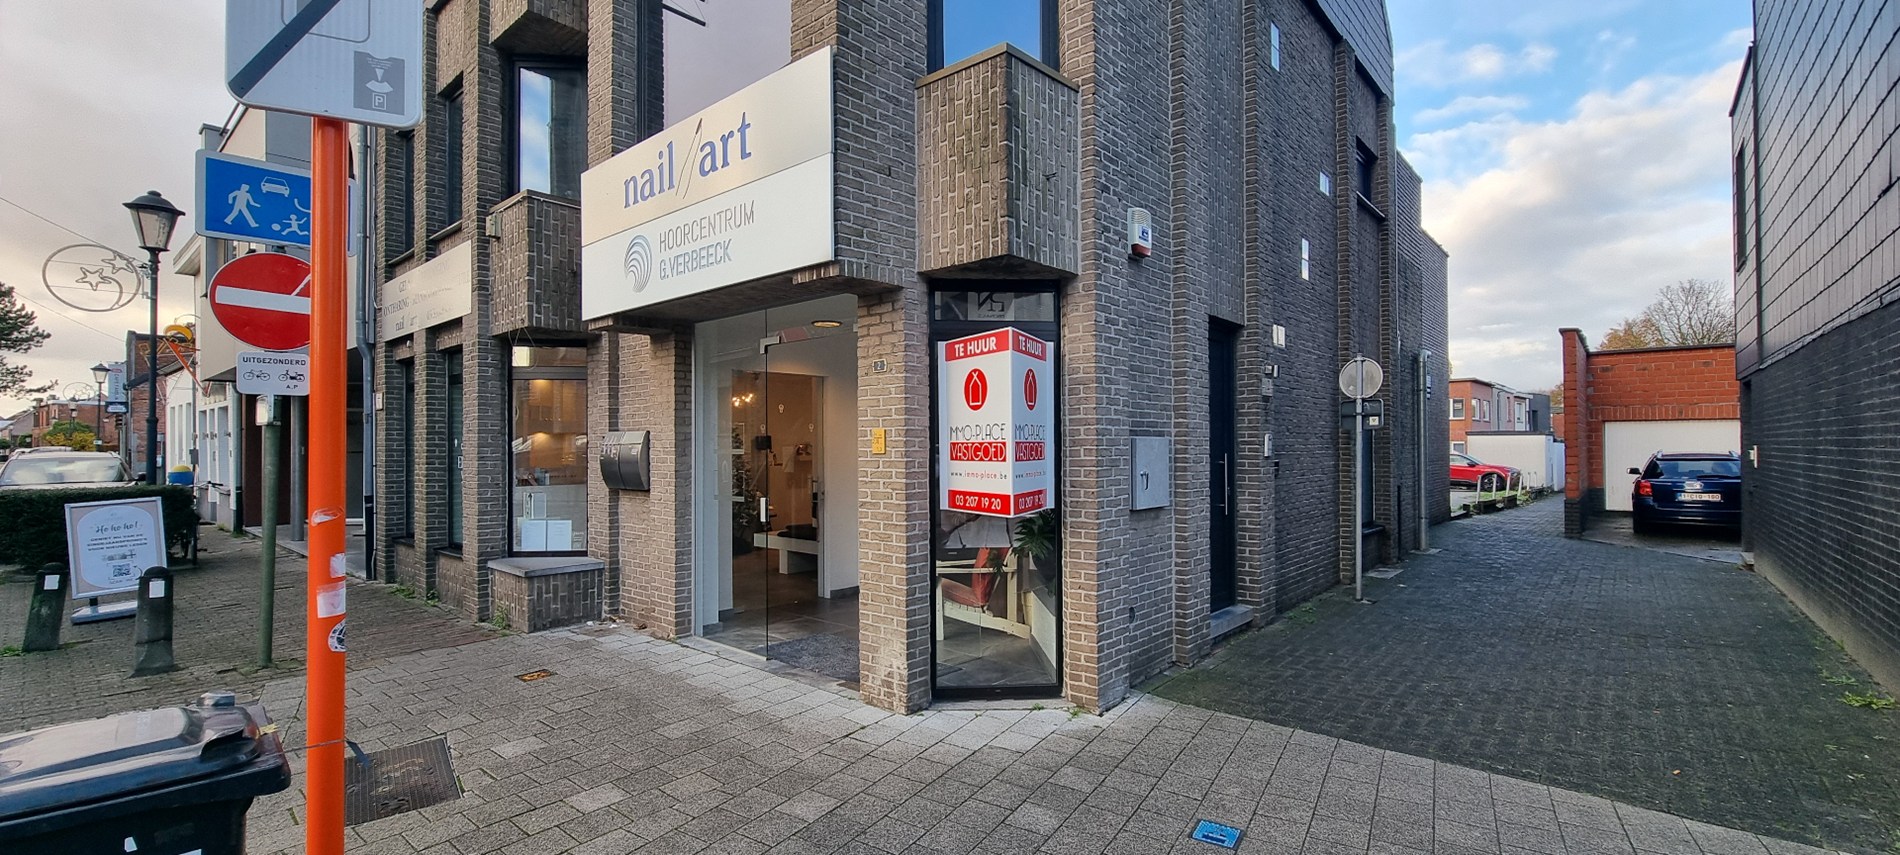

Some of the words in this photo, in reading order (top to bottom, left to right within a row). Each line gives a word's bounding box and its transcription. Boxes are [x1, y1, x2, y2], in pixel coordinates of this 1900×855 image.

[375, 95, 383, 106] P
[623, 140, 675, 209] nail
[699, 112, 752, 177] art
[659, 200, 755, 253] HOORCENTRUM
[659, 238, 732, 280] G.VERBEECK
[954, 343, 964, 357] TE
[967, 336, 997, 354] HUUR
[1018, 335, 1026, 351] TE
[1027, 338, 1042, 356] HUUR
[242, 356, 306, 366] UITGEZONDERD
[950, 443, 1005, 461] VASTGOED
[1015, 443, 1045, 460] VASTGOED
[951, 470, 1007, 480] www.immo-place.be
[955, 495, 963, 506] 03
[966, 496, 978, 507] 207
[981, 497, 989, 508] 19
[991, 498, 1001, 510] 20
[95, 524, 108, 534] Ho
[111, 524, 121, 532] ho
